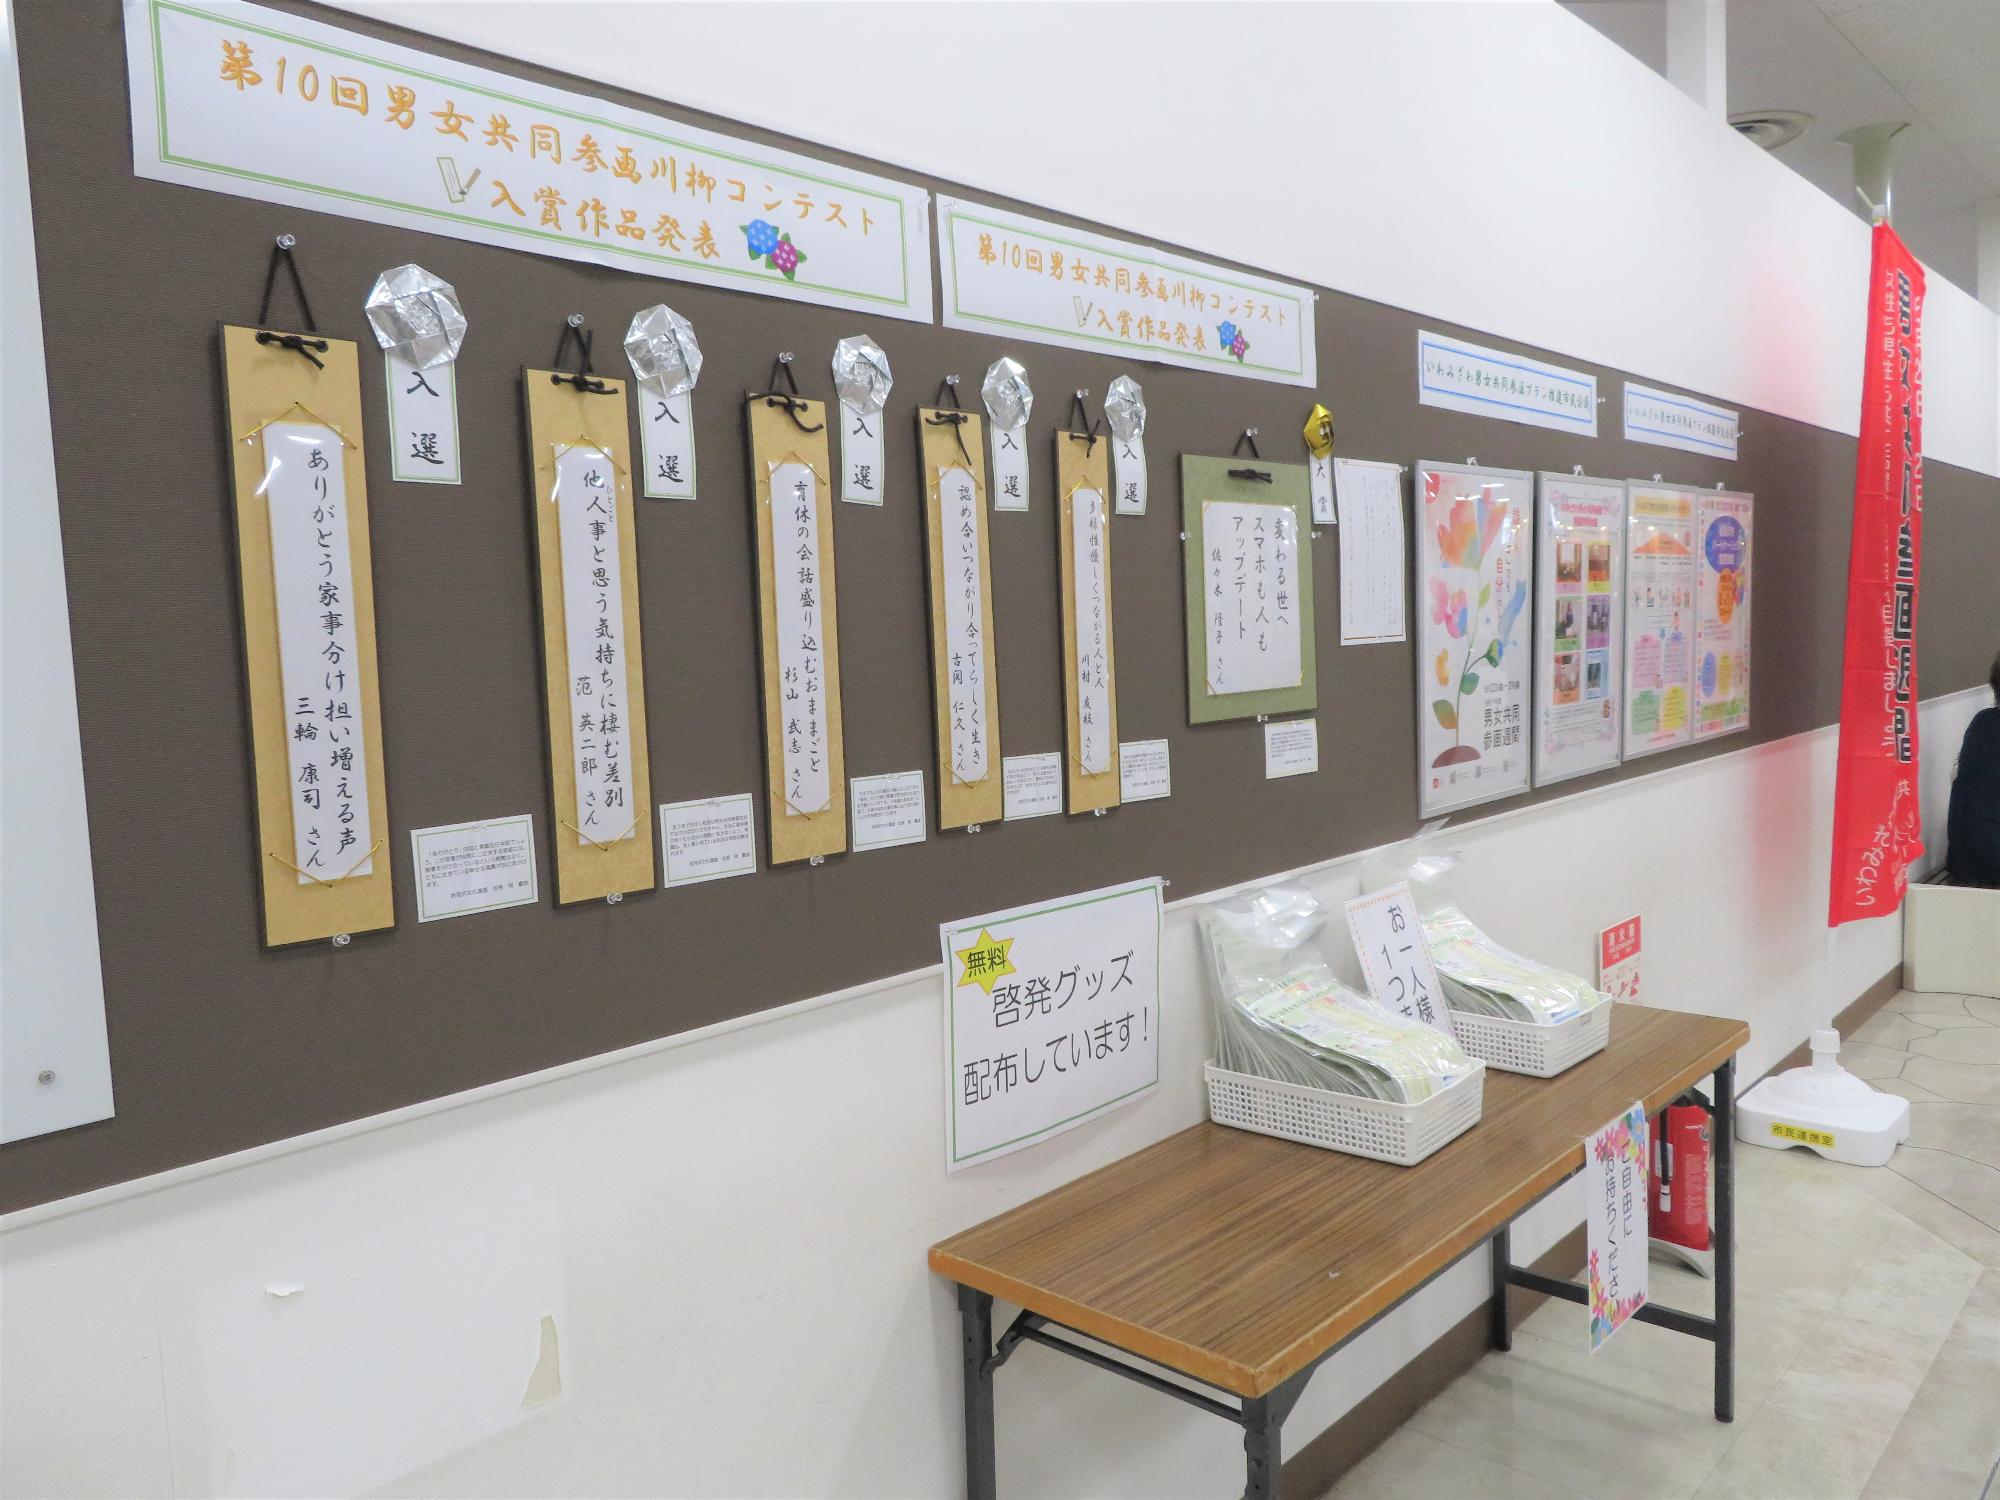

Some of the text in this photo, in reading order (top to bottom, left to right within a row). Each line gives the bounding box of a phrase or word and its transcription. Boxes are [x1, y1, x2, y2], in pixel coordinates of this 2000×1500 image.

[218, 39, 876, 236] 第10回男女共同参画川柳コンテスト
[490, 179, 720, 260] 入賞作品発表
[977, 231, 1287, 327] 第10回男女共同参画川柳コンテスト
[1097, 308, 1208, 352] 入賞作品発表
[406, 371, 445, 465] 入選
[654, 401, 684, 483] 入選
[852, 417, 874, 490] 入選
[1001, 432, 1021, 498] 入選
[1122, 444, 1140, 503] 入選
[1315, 462, 1328, 514] 大賞
[1231, 516, 1247, 641] アップデート
[1253, 517, 1270, 652] スマホも人も
[1273, 517, 1289, 626] 変わる世へ
[307, 447, 358, 855] ありがとう家事分け担い増える声
[583, 469, 624, 808] 他人事と思う気持ちに棲む差別
[784, 666, 799, 700] 杉山
[293, 697, 327, 869] 三輪 康司 さん
[579, 712, 598, 777] 英二郎
[790, 767, 803, 800] さん
[584, 790, 600, 826] さん
[967, 944, 1007, 979] 無料
[991, 949, 1135, 1029] 啓発グッズ
[1387, 903, 1436, 1025] お一人様
[963, 1005, 1149, 1107] 配布しています!
